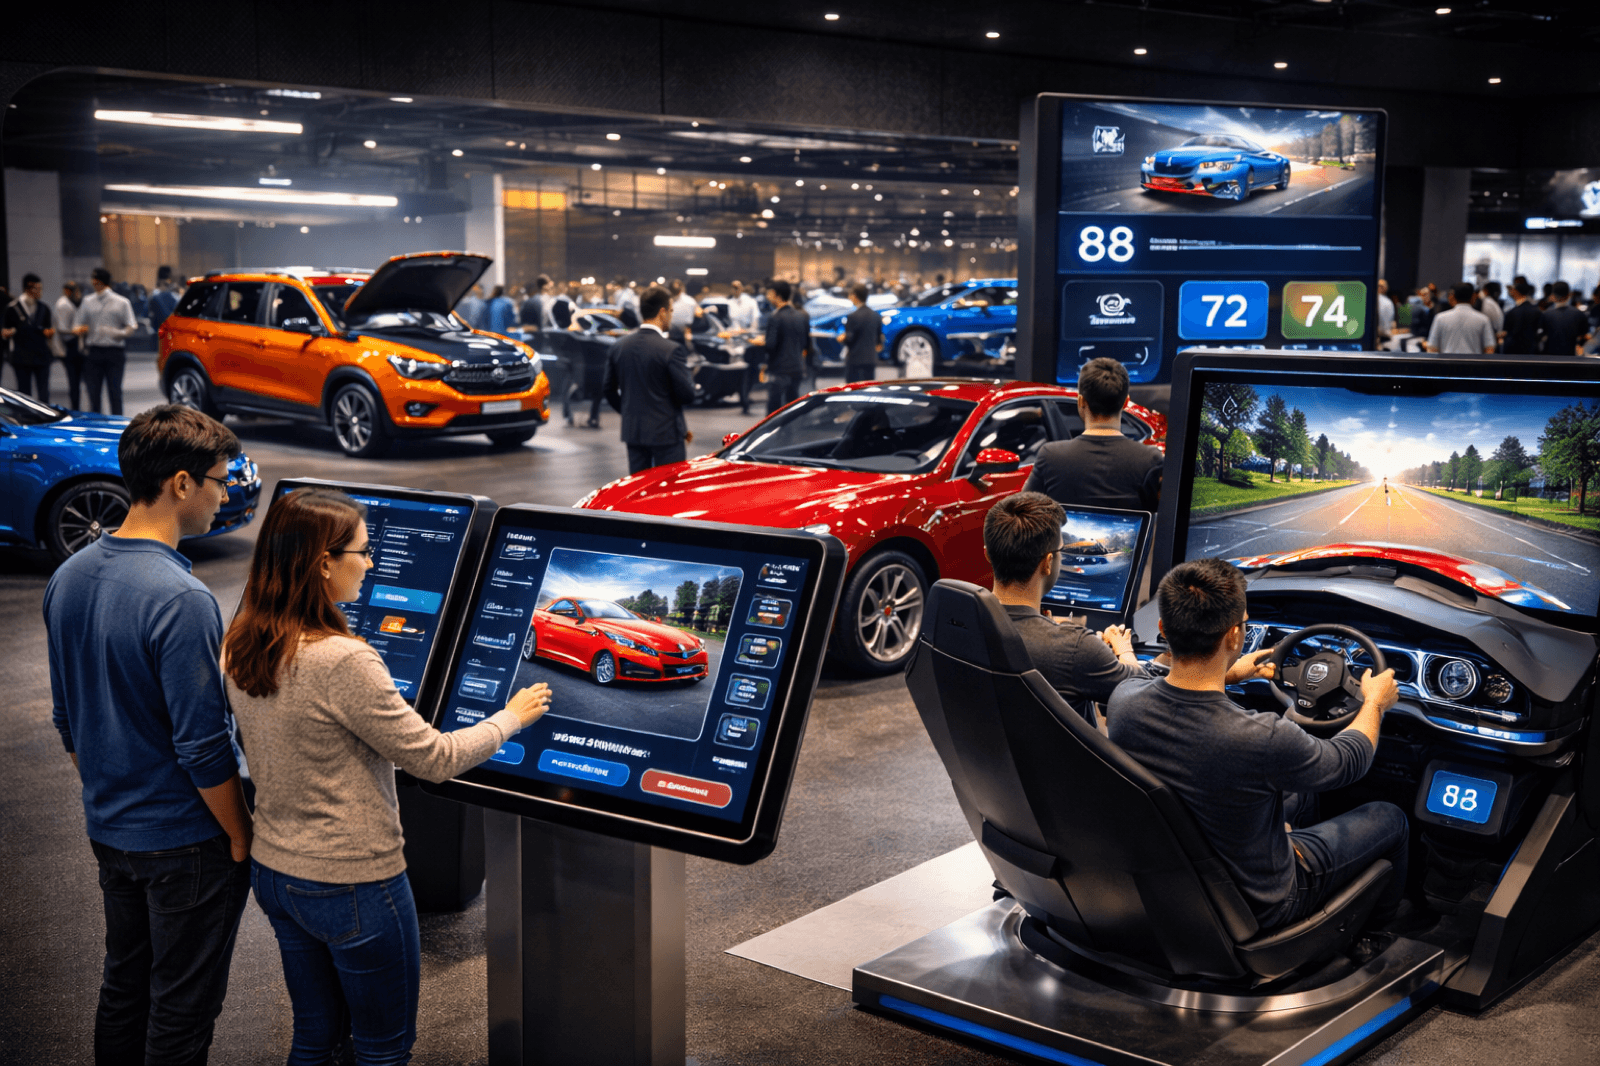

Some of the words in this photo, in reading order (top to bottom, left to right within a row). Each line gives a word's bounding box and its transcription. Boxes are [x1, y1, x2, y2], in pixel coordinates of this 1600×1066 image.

[1078, 225, 1135, 263] 88
[1201, 295, 1248, 328] 72
[1301, 295, 1348, 328] 74
